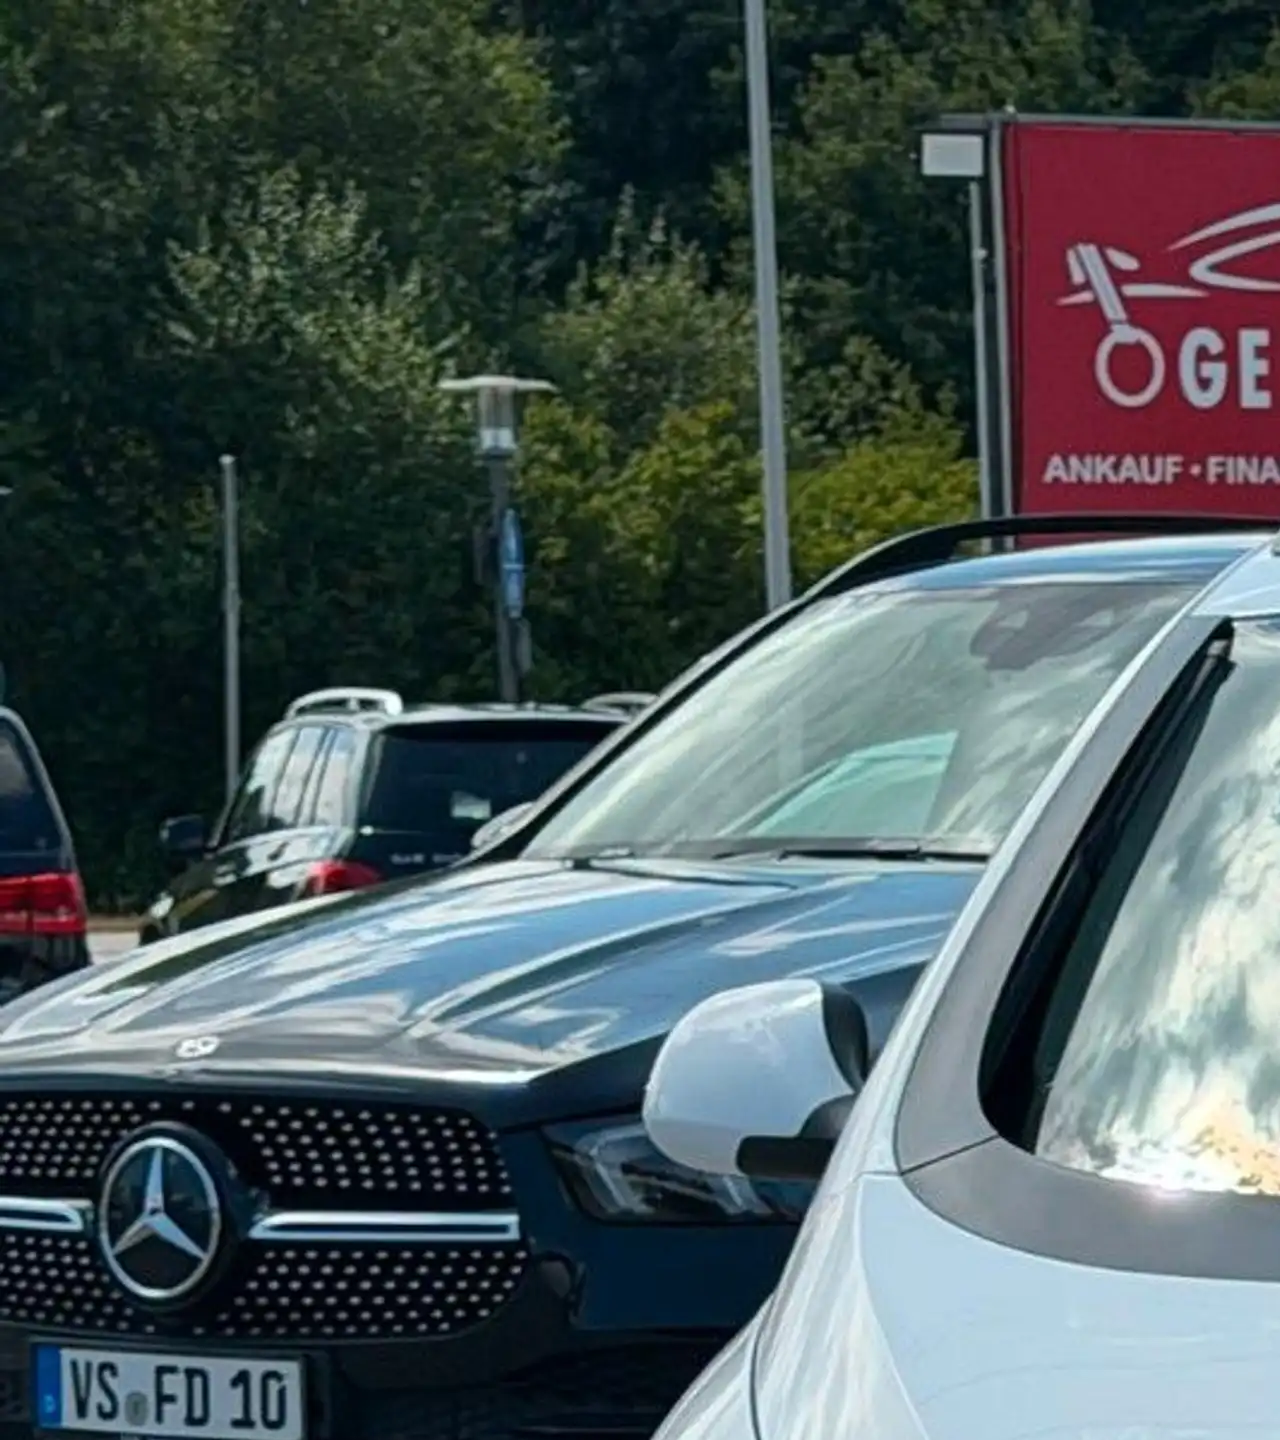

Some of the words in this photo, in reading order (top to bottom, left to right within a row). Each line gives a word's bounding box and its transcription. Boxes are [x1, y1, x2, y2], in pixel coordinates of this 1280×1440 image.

[1043, 454, 1184, 485] ANKAUF
[70, 1358, 119, 1421] VS
[154, 1365, 210, 1427] FD
[230, 1369, 287, 1430] 10
